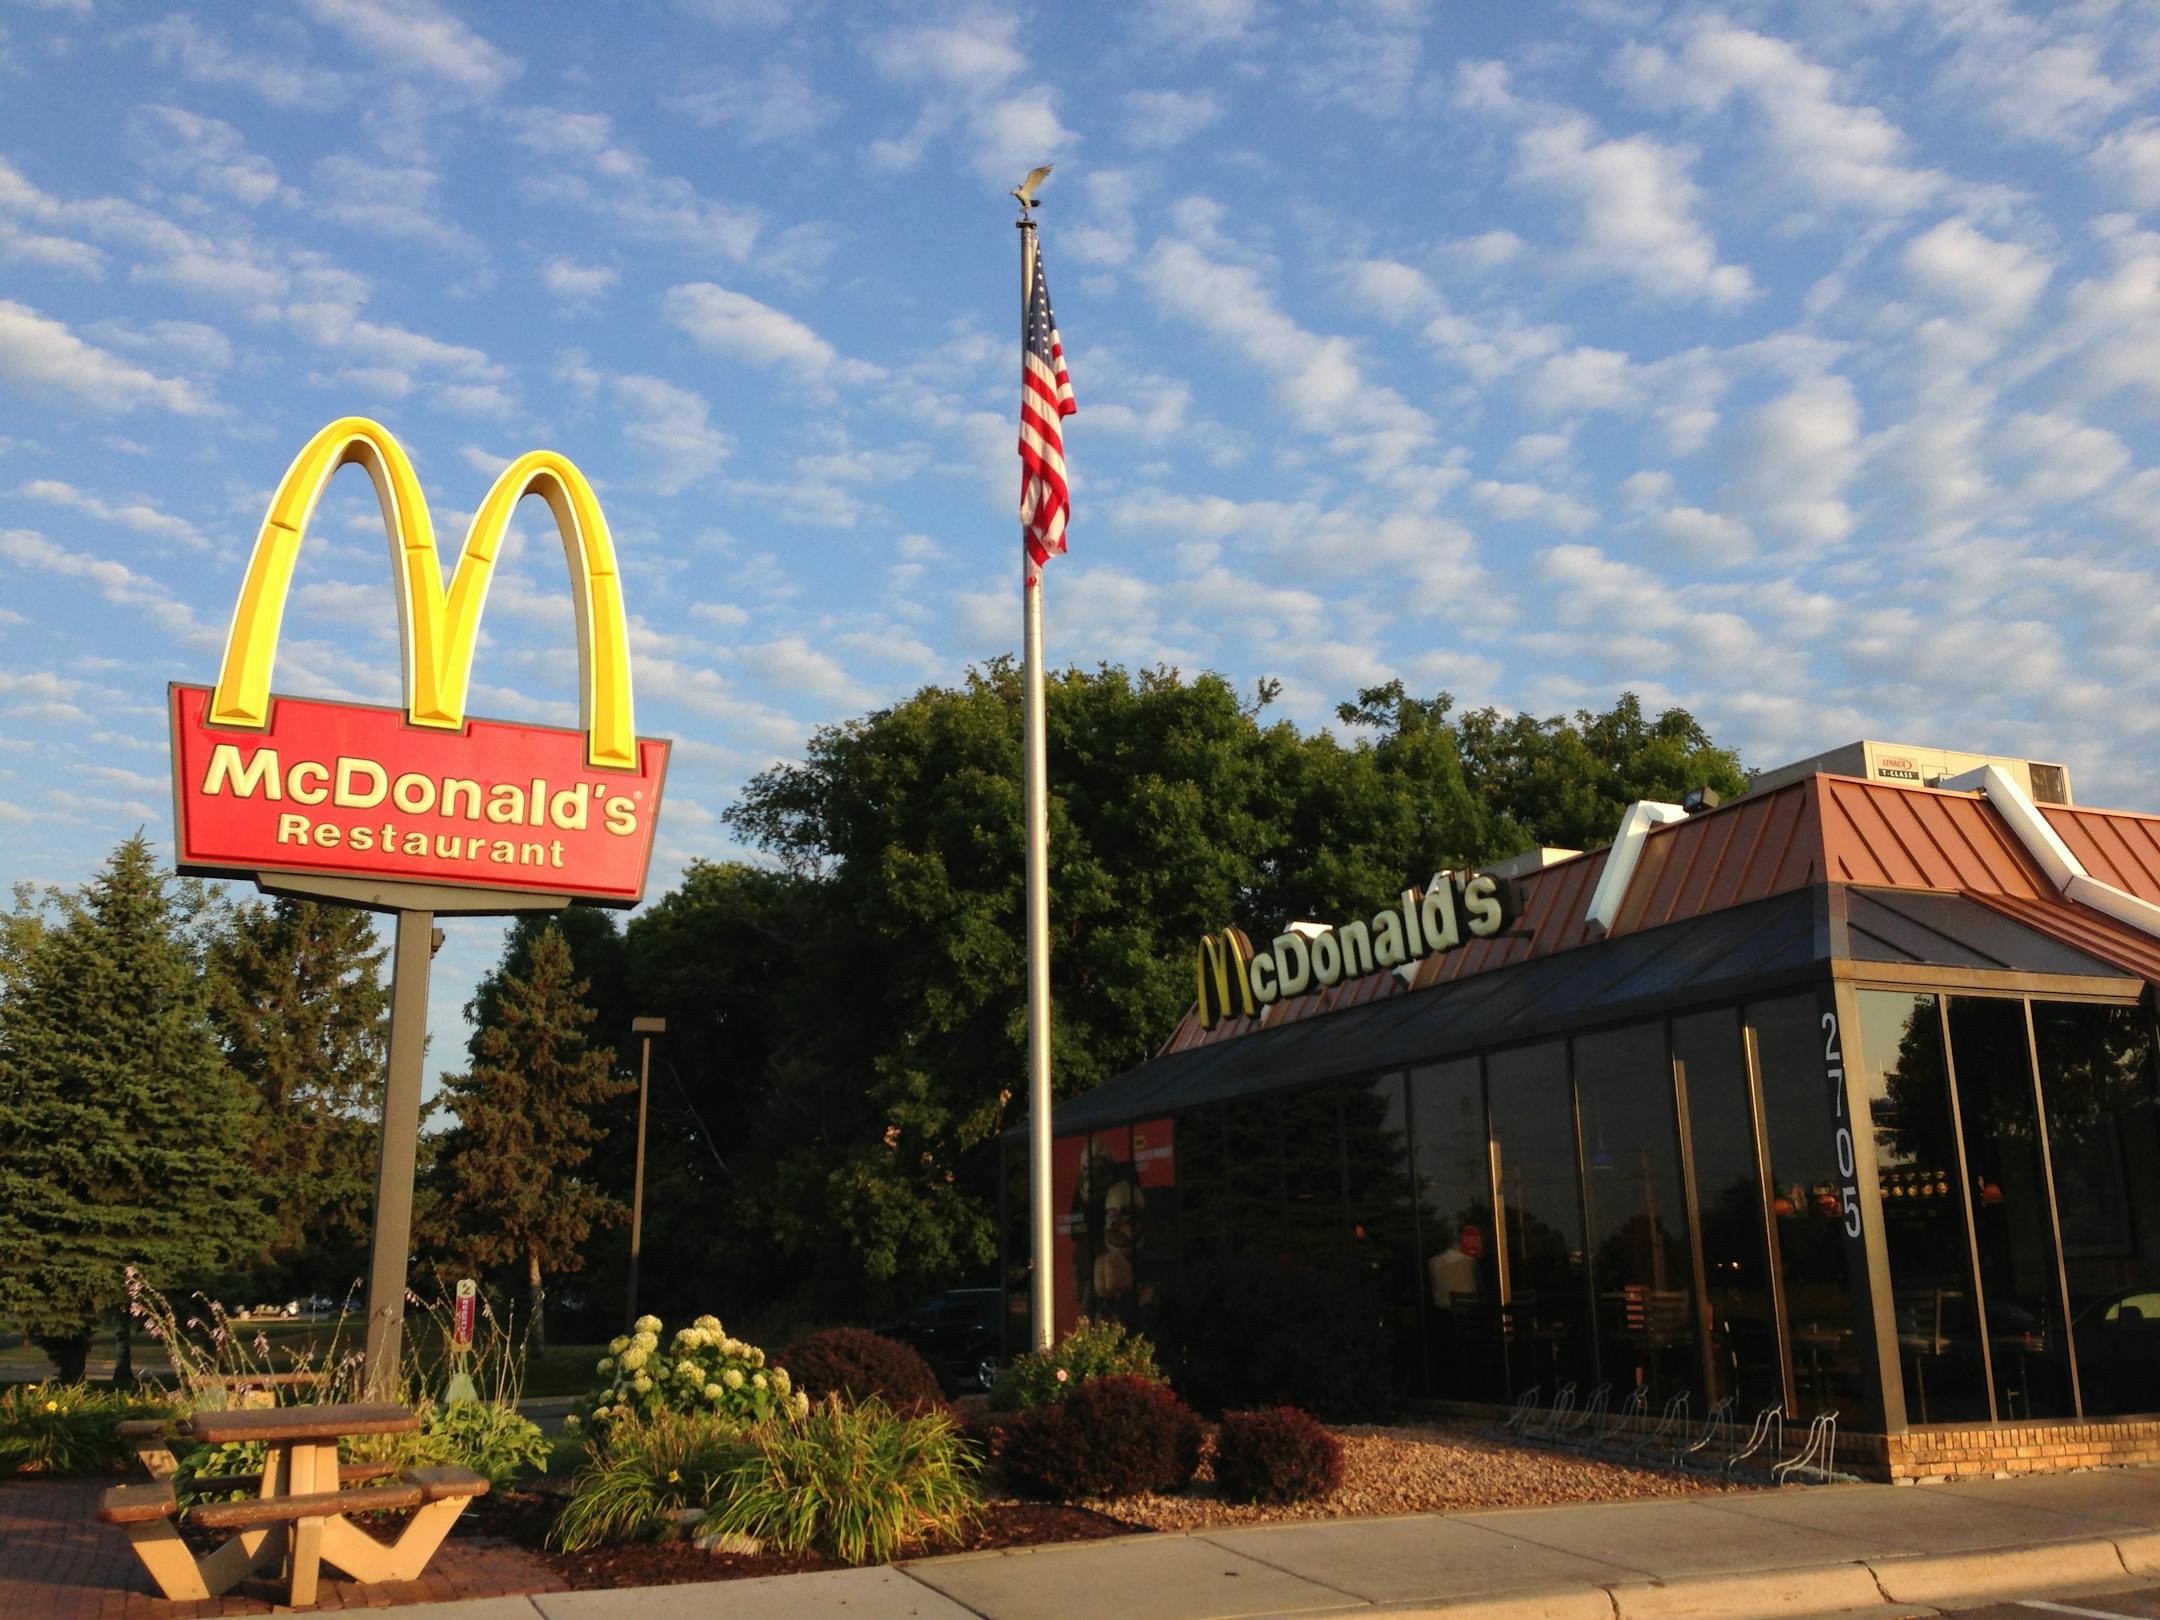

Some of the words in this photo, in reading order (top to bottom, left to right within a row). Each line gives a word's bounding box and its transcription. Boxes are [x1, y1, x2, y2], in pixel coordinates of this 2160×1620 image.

[202, 744, 638, 836] McDonald's
[277, 813, 565, 868] Restaurant
[1198, 869, 1503, 1028] McDonald's
[1821, 1012, 1861, 1238] 2705
